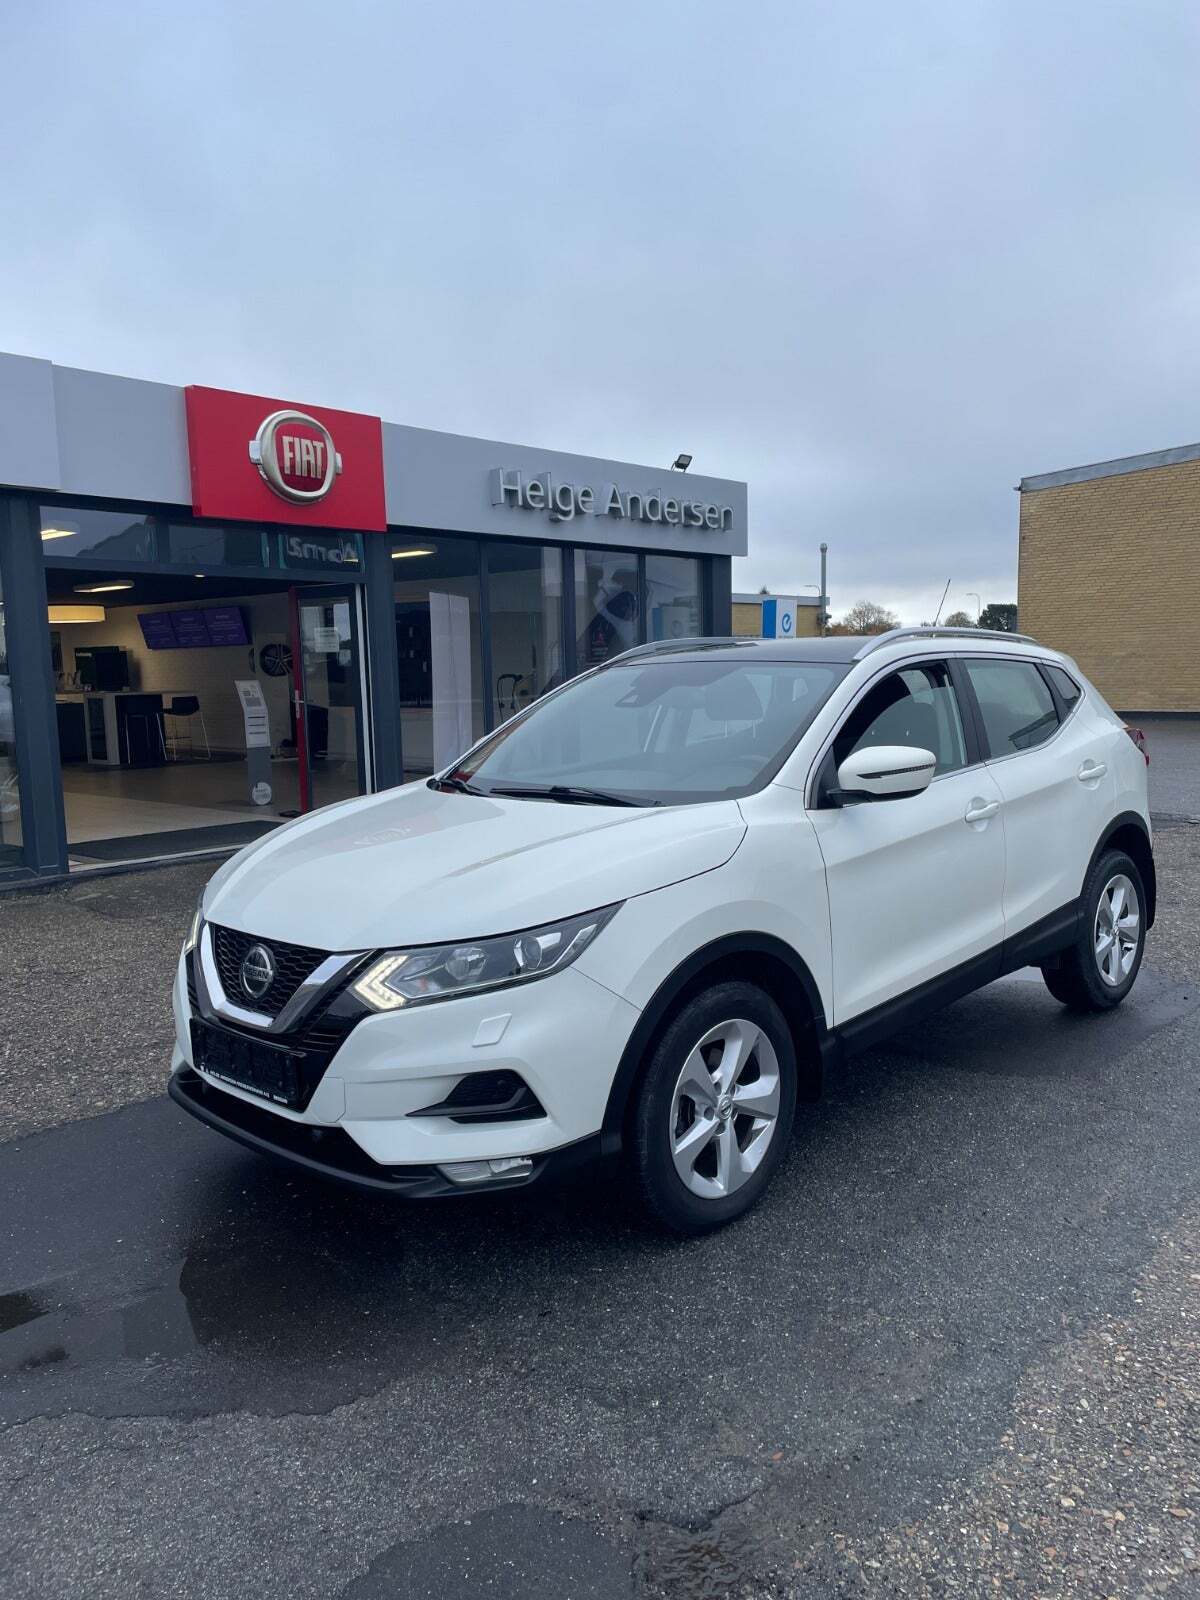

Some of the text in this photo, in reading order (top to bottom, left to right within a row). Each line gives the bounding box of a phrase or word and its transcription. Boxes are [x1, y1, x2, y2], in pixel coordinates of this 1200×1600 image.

[282, 435, 325, 478] FIAT
[498, 468, 734, 530] Helge Andersen
